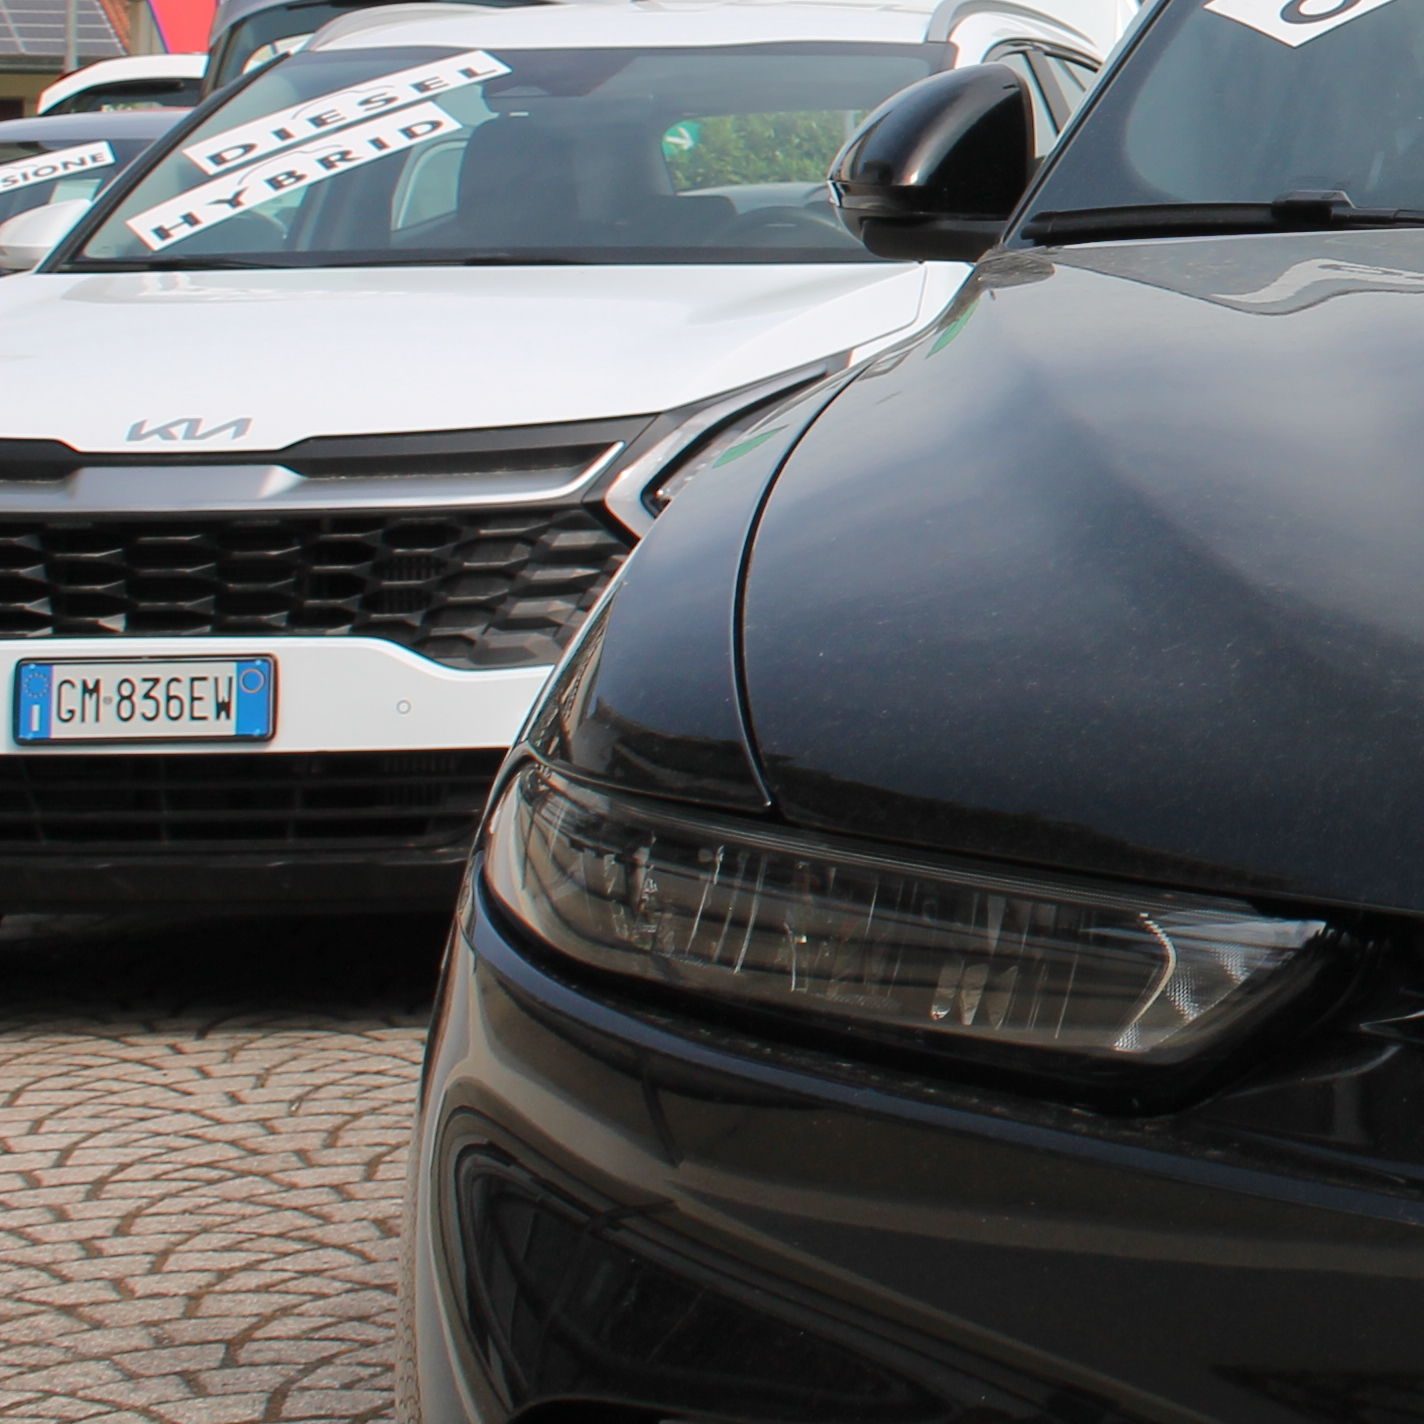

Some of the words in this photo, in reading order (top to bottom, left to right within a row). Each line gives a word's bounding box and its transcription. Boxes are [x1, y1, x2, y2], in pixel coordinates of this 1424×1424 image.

[205, 66, 498, 167] DIESEL
[150, 118, 445, 241] HYBRID
[126, 417, 254, 443] KIA
